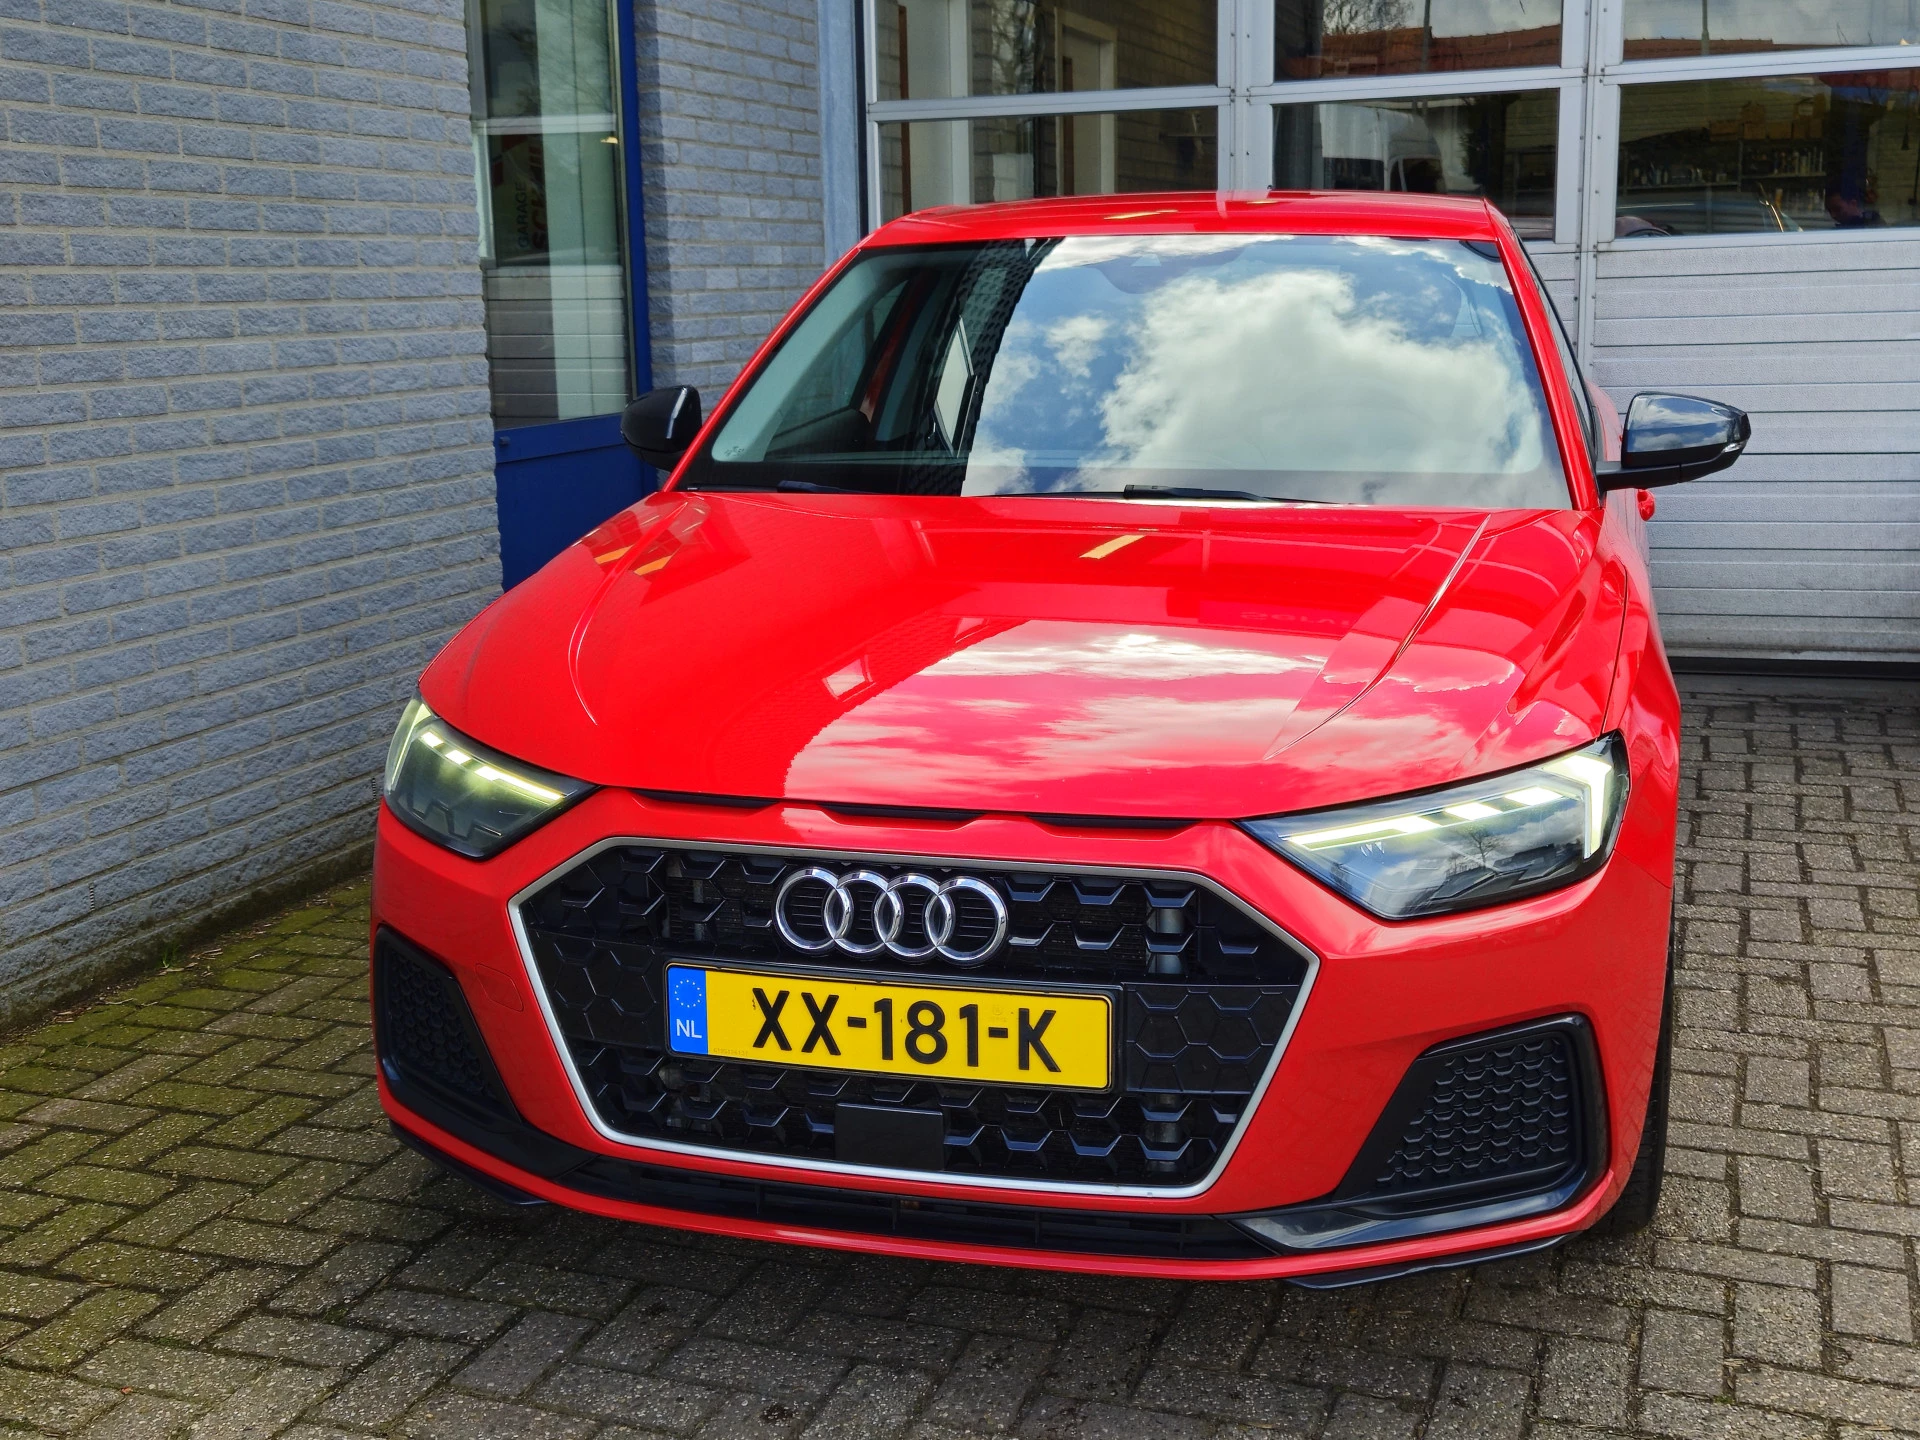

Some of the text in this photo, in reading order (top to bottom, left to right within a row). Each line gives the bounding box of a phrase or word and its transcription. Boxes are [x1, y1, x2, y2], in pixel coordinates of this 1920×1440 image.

[514, 181, 529, 248] GARAGE
[676, 1018, 702, 1039] NL
[752, 987, 1062, 1073] XX-181-K
